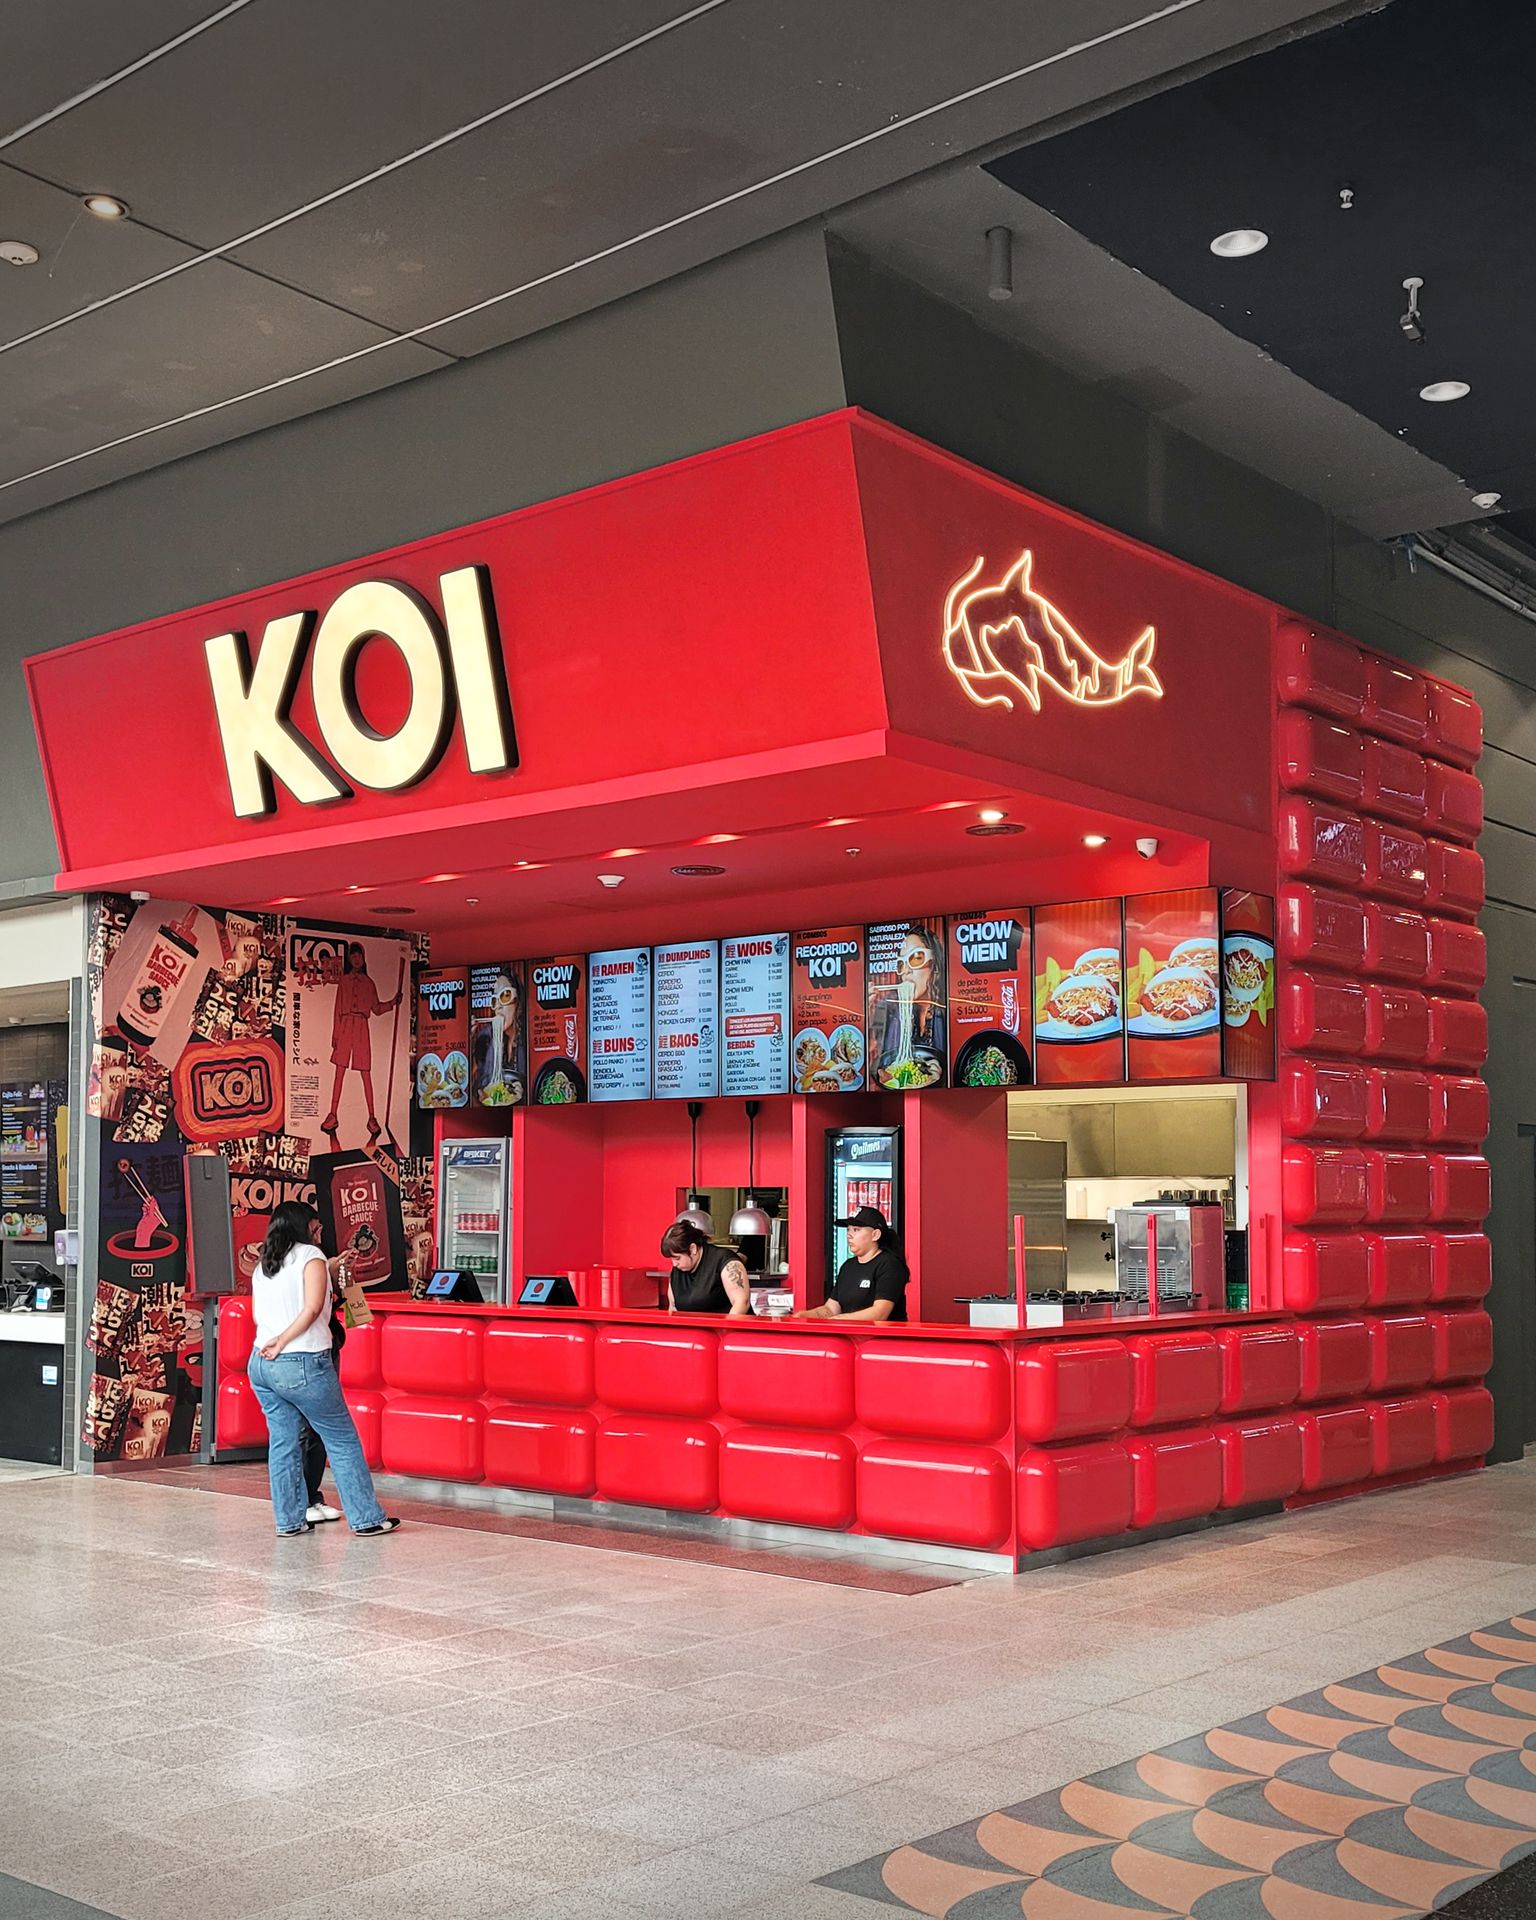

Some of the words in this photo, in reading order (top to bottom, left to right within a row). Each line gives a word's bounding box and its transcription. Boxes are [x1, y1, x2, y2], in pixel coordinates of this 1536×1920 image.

[204, 564, 519, 818] KOI
[869, 925, 897, 933] SABROSO
[956, 920, 1013, 943] CHOW
[869, 933, 906, 943] NATURALEZA
[294, 939, 344, 976] KOI
[666, 949, 710, 962] DUMPLINGS
[737, 940, 772, 958] WOKS
[796, 942, 857, 958] RECORRIDO
[962, 942, 1007, 963] MEIN
[150, 944, 188, 978] KOI
[601, 962, 634, 976] RAMEN
[809, 957, 842, 978] KOI
[533, 965, 574, 984] CHOW
[420, 980, 464, 994] RECORRIDO
[537, 983, 569, 1001] MEIN
[429, 993, 452, 1011] KOI
[957, 1007, 963, 1015] $
[964, 1006, 988, 1015] 15.000
[604, 1037, 635, 1053] BUNS
[670, 1033, 699, 1048] BAOS
[727, 1040, 755, 1050] BEBIDAS
[200, 1068, 260, 1110] KOI
[851, 1141, 880, 1160] Quilmes
[231, 1178, 282, 1210] KOI
[340, 1182, 378, 1207] KOI
[342, 1201, 379, 1218] BARBECUE
[350, 1212, 374, 1225] SAUCE
[133, 1265, 151, 1275] KOI
[152, 1418, 168, 1427] KOI
[127, 1441, 143, 1450] KOI
